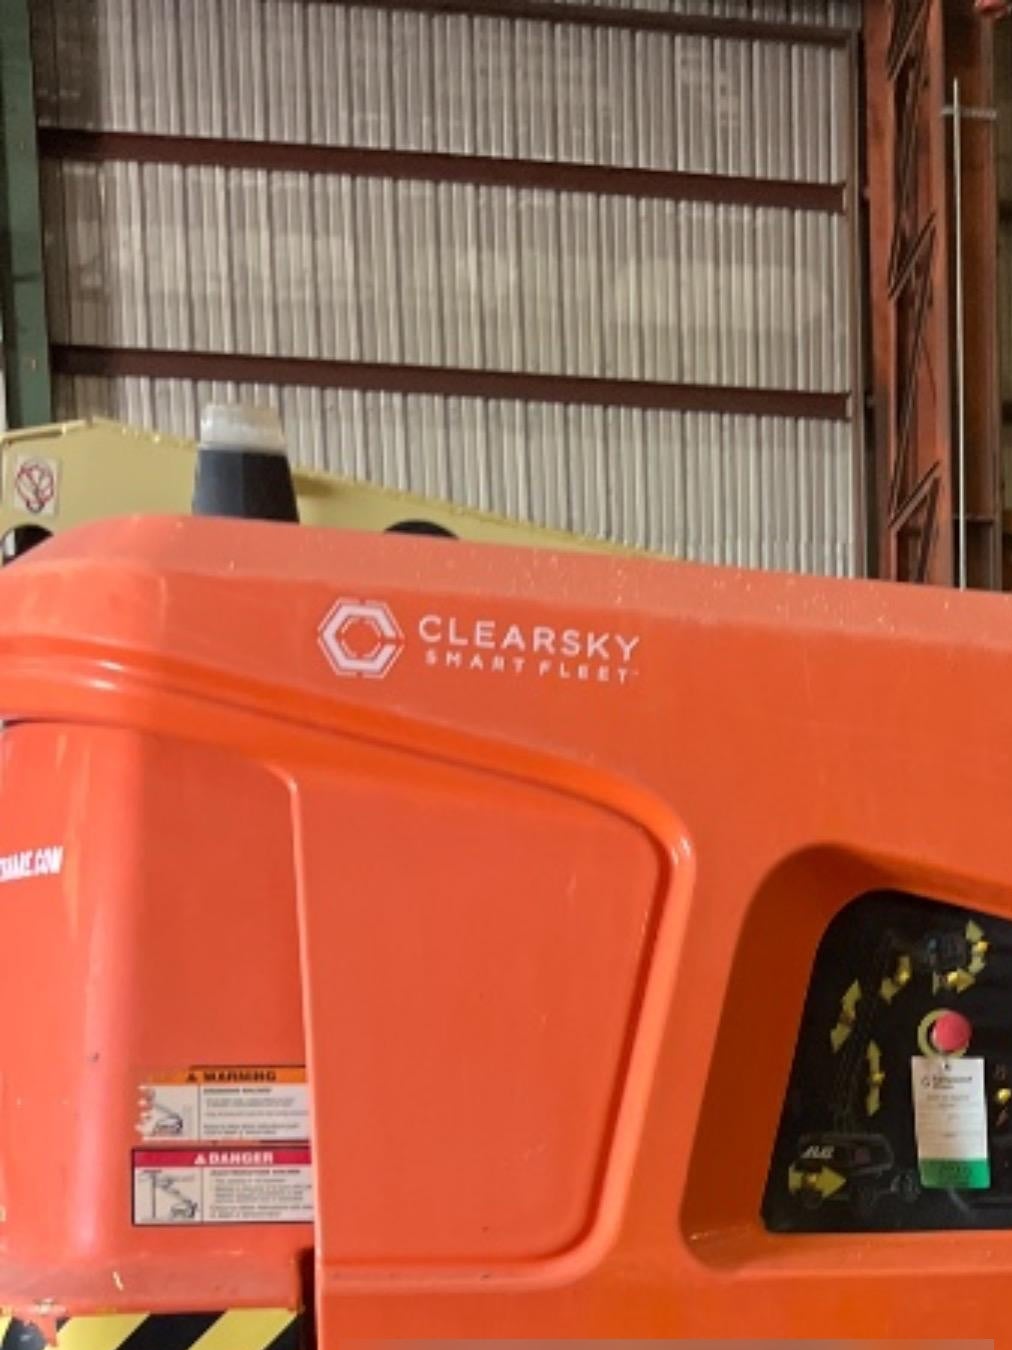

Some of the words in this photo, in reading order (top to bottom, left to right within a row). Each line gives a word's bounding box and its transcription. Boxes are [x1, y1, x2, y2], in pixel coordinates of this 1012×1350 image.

[418, 614, 640, 662] CLEARSKY
[425, 649, 526, 673] SMART
[538, 658, 634, 684] FLEET
[208, 1151, 274, 1165] DANGER
